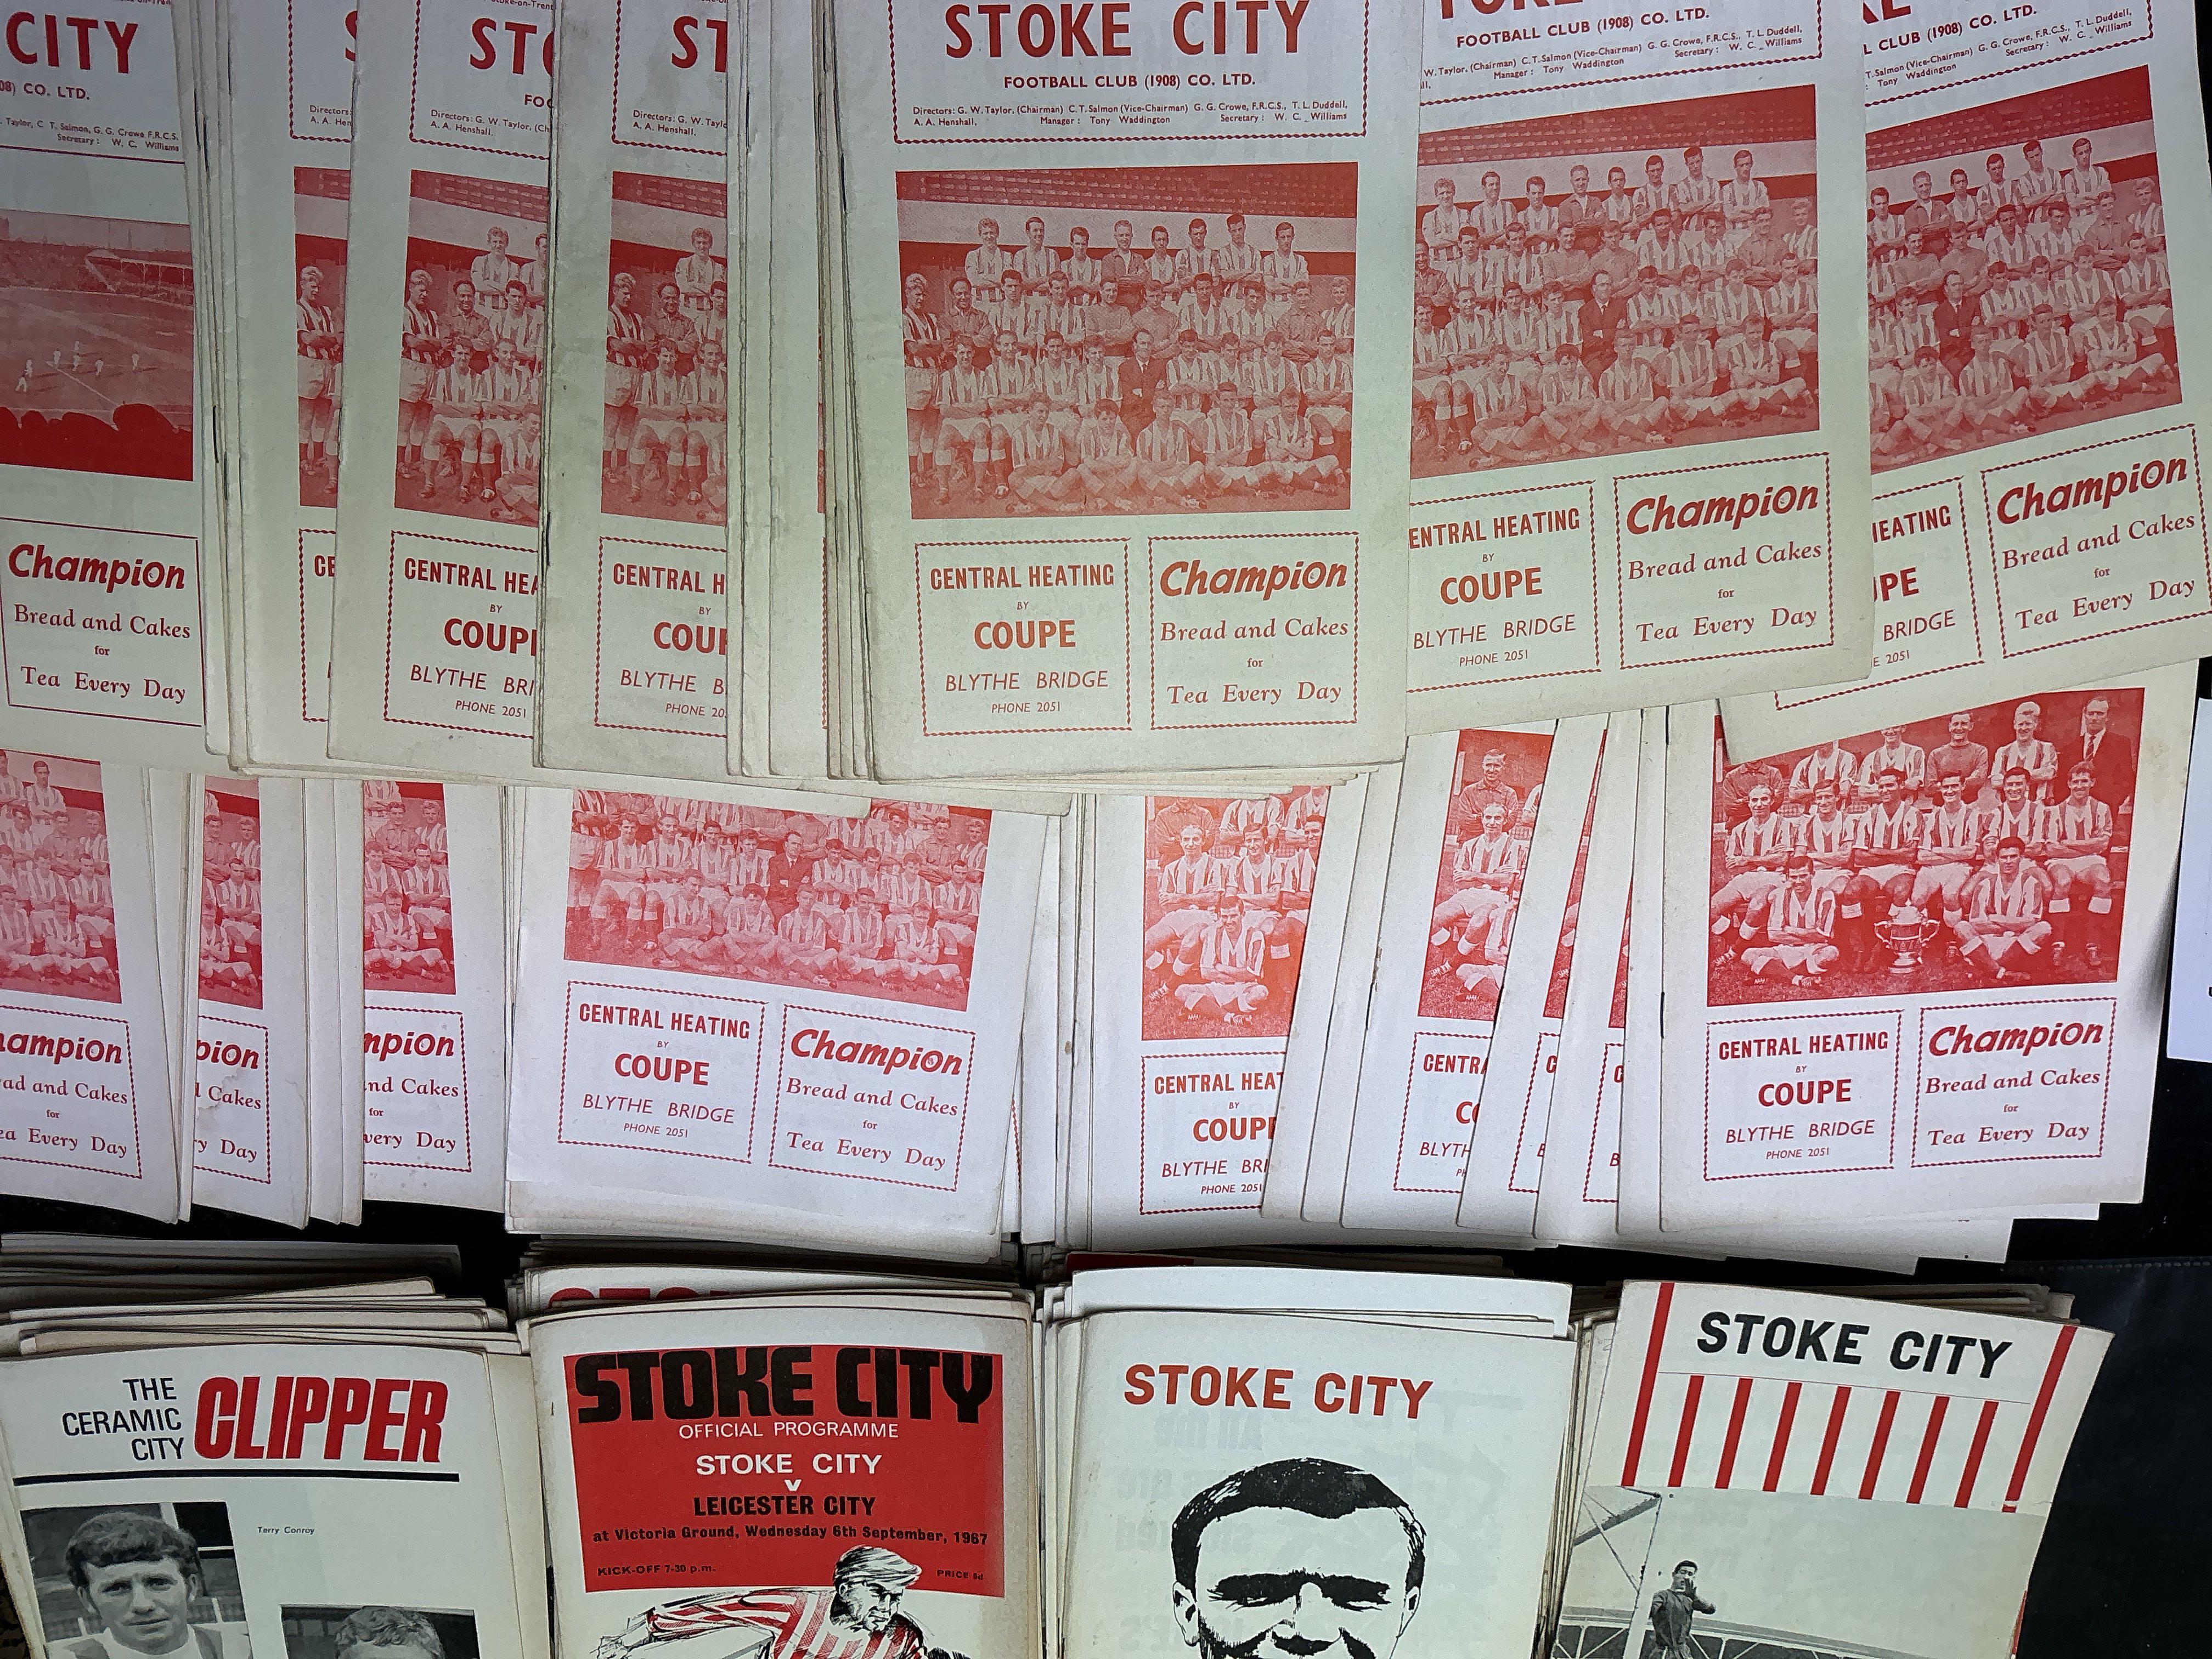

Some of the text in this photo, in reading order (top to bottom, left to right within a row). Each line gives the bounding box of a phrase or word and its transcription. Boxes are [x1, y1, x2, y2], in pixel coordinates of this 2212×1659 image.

[945, 0, 1310, 58] STOKE CITY
[1457, 8, 1709, 48] FOOTBALL CLUB (1908) CO. LTD.
[1879, 5, 2036, 50] CLUB (1908) CO. LTD.
[6, 12, 138, 74] CITY
[24, 83, 50, 96] CO.
[58, 86, 89, 100] LTD.
[1005, 74, 1255, 91] FOOTBALL CLUB (1908) CO. LTD.
[431, 109, 473, 122] Directors:
[503, 119, 532, 131] Taylor,
[913, 106, 955, 115] Directors:
[970, 106, 983, 114] W.
[985, 106, 1014, 115] Taylor,
[1017, 105, 1063, 115] (Chairman)
[1069, 105, 1077, 113] C.
[1088, 105, 1118, 113] Salmon
[1120, 104, 1188, 114] (Vice-Chairman)
[1218, 103, 1249, 111] Crowe,
[1312, 100, 1347, 109] Duddell,
[926, 117, 935, 126] A.
[939, 118, 977, 126] Henshall,
[1090, 116, 1110, 126] Tony
[1119, 115, 1170, 125] Waddington
[1275, 112, 1287, 121] W.
[1311, 112, 1347, 121] Williams
[455, 124, 493, 136] Henshall,
[1997, 458, 2187, 524] Champion
[1627, 486, 1818, 534] Champion
[2002, 514, 2194, 569] Bread and Cakes
[9, 544, 184, 593] Champion
[405, 558, 496, 590] CENTRAL
[613, 563, 705, 593] CENTRAL
[930, 564, 1114, 590] CENTRAL HEATING
[1160, 560, 1347, 601] Champion
[1441, 567, 1542, 605] COUPE
[1017, 602, 1029, 610] BY
[14, 604, 190, 638] Bread and Cakes
[1160, 617, 1348, 641] Bread and Cakes
[1414, 614, 1576, 649] BLYTHE BRIDGE
[1635, 608, 1816, 642] Tea Every Day
[974, 620, 1076, 650] COUPE
[1247, 658, 1263, 668] for
[1460, 650, 1527, 667] PHONE 2051
[620, 670, 697, 692] BLYTHE
[946, 670, 1108, 691] BLYTHE BRIDGE
[1167, 682, 1341, 705] Tea Every Day
[455, 701, 526, 718] PHONE 2051
[992, 701, 1059, 713] PHONE 2051
[579, 1003, 749, 1039] CENTRAL HEATING
[791, 1029, 962, 1075] Champion
[1719, 1031, 1888, 1060] CENTRAL HEATING
[1929, 1023, 2103, 1057] Champion
[615, 1053, 709, 1086] COUPE
[402, 1079, 458, 1097] Cakes
[786, 1077, 957, 1115] Bread and Cakes
[1155, 1074, 1234, 1094] CENTRAL
[1759, 1079, 1852, 1107] COUPE
[208, 1086, 261, 1109] Cakes
[583, 1094, 735, 1124] BLYTHE BRIDGE
[28, 1128, 77, 1150] Every
[91, 1136, 126, 1158] Day
[1726, 1120, 1875, 1143] BLYTHE BRIDGE
[1928, 1123, 2089, 1146] Tea Every Day
[1766, 1148, 1829, 1159] PHONE 2051
[1201, 1183, 1262, 1194] PHONE 2051
[1697, 1312, 2013, 1378] STOKE CITY
[122, 1378, 177, 1401] THE
[574, 1346, 994, 1424] STOKE CITY
[1125, 1364, 1433, 1419] STOKE CITY
[63, 1408, 182, 1436] CERAMIC
[194, 1376, 448, 1463] CLIPPER
[679, 1421, 898, 1439] OFFICIAL PROGRAMME
[132, 1437, 184, 1460] CITY
[697, 1454, 882, 1475] STOKE CITY
[693, 1496, 876, 1516] LEICESTER CITY
[284, 1527, 314, 1535] Conroy
[594, 1525, 987, 1545] at Victoria Ground, Wednesday 6th September, 1967
[598, 1565, 660, 1576] KICK-OFF
[690, 1566, 716, 1574] p.m.
[937, 1570, 968, 1578] PRICE
